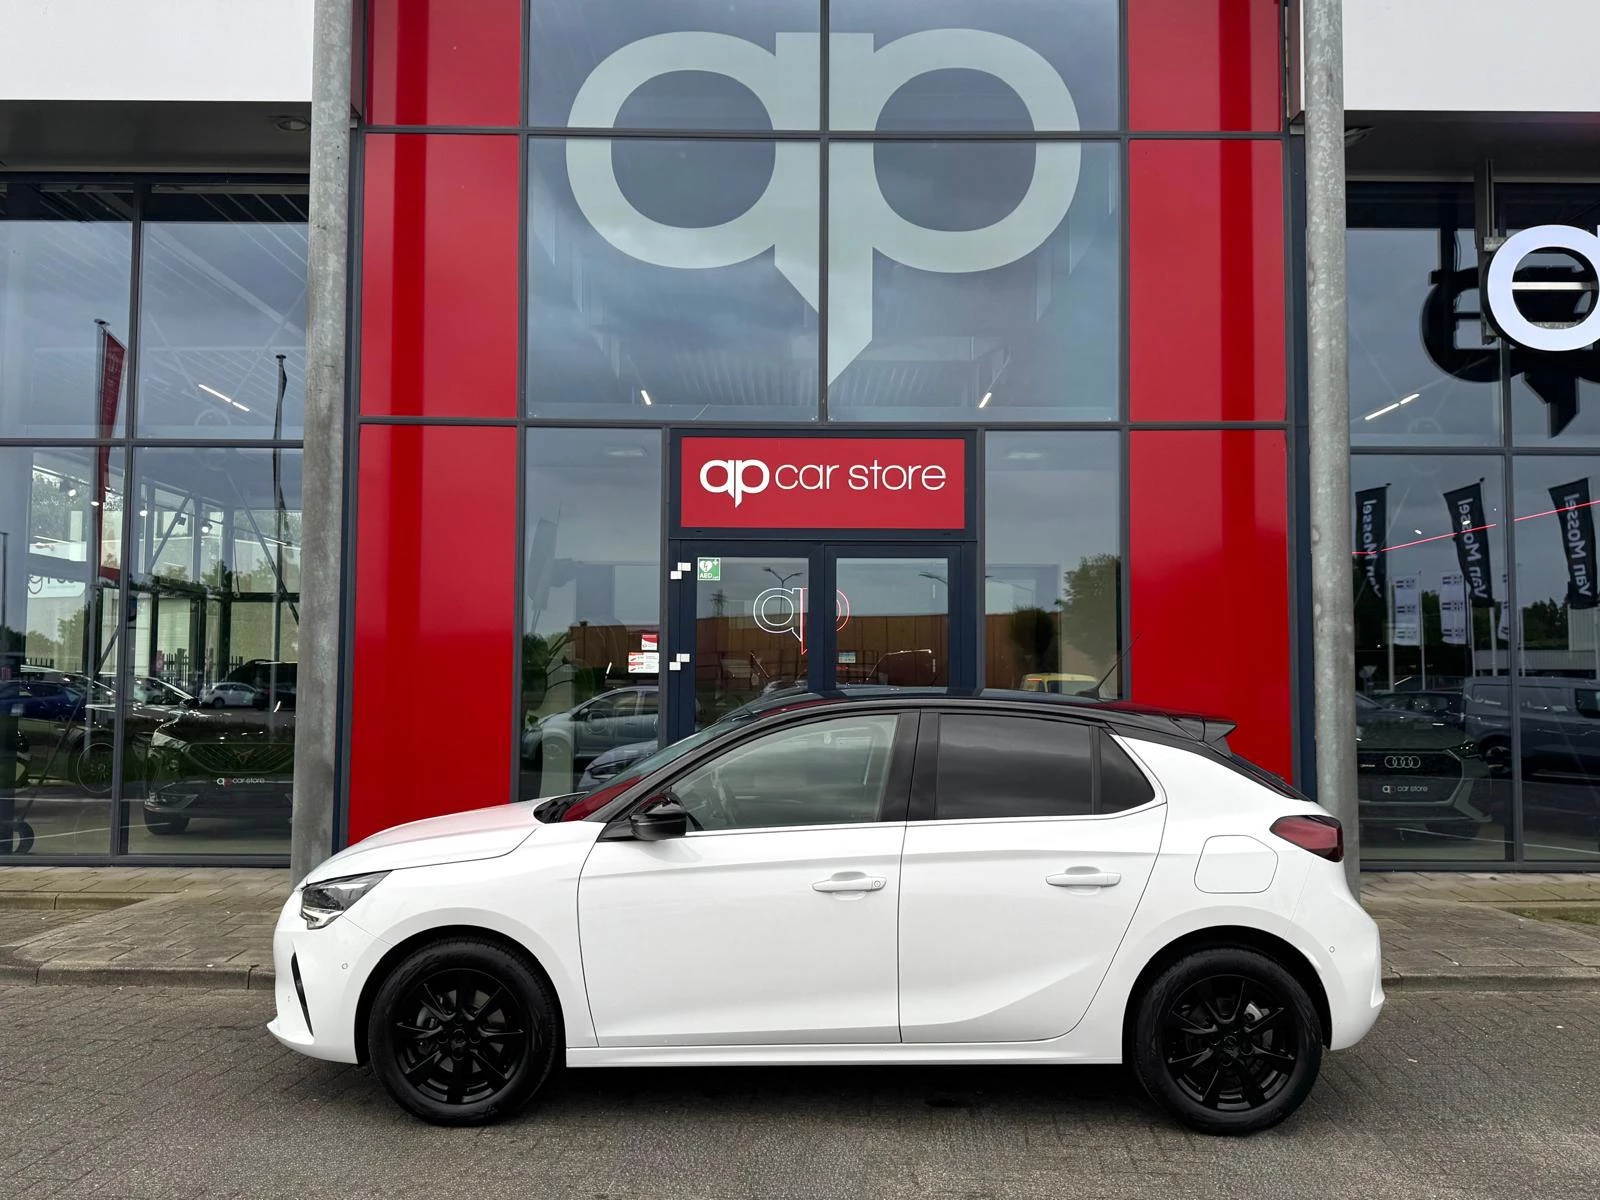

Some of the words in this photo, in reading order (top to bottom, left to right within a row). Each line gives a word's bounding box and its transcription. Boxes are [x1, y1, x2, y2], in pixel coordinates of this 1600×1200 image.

[699, 459, 770, 508] ap
[775, 464, 840, 490] car
[847, 459, 946, 491] store
